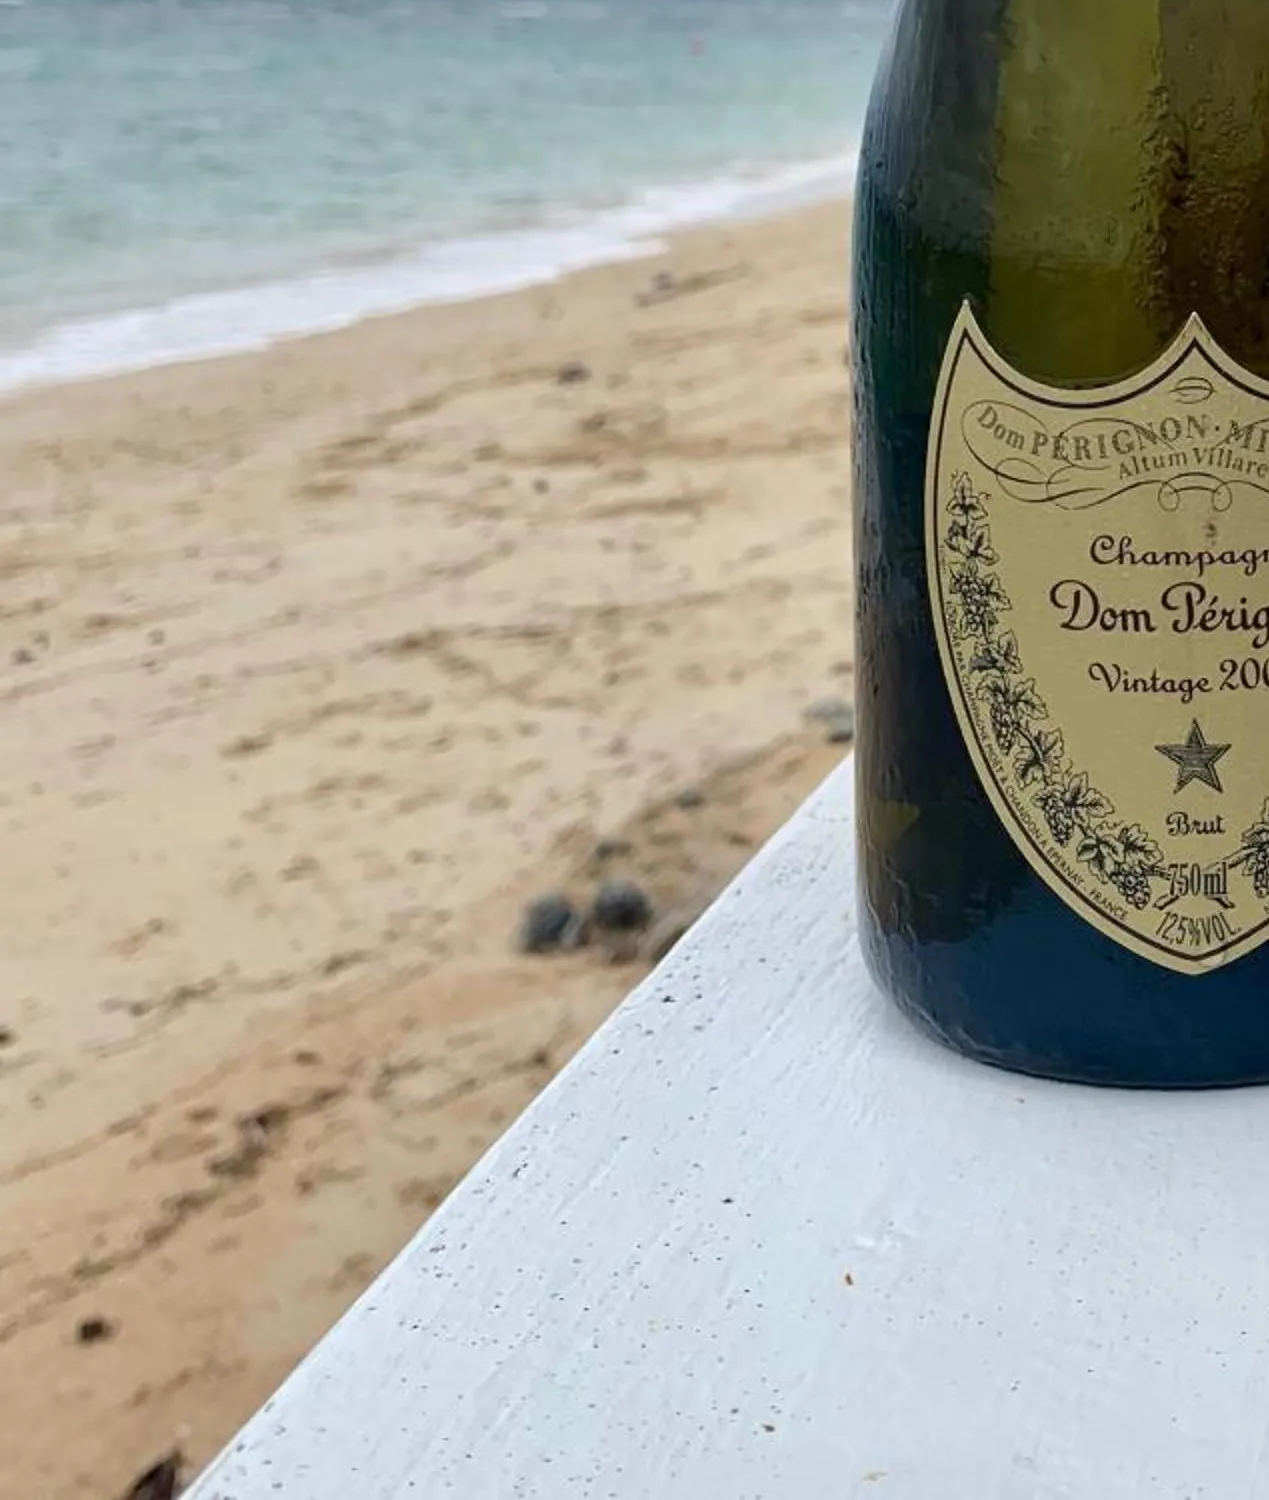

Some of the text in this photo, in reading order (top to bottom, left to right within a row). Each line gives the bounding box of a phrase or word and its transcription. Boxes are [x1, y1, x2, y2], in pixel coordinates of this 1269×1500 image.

[977, 405, 1025, 451] Dom
[1119, 447, 1269, 479] Altum Villare
[1050, 579, 1156, 632] Dom
[1088, 662, 1212, 704] Vintage
[1165, 811, 1226, 836] Brut
